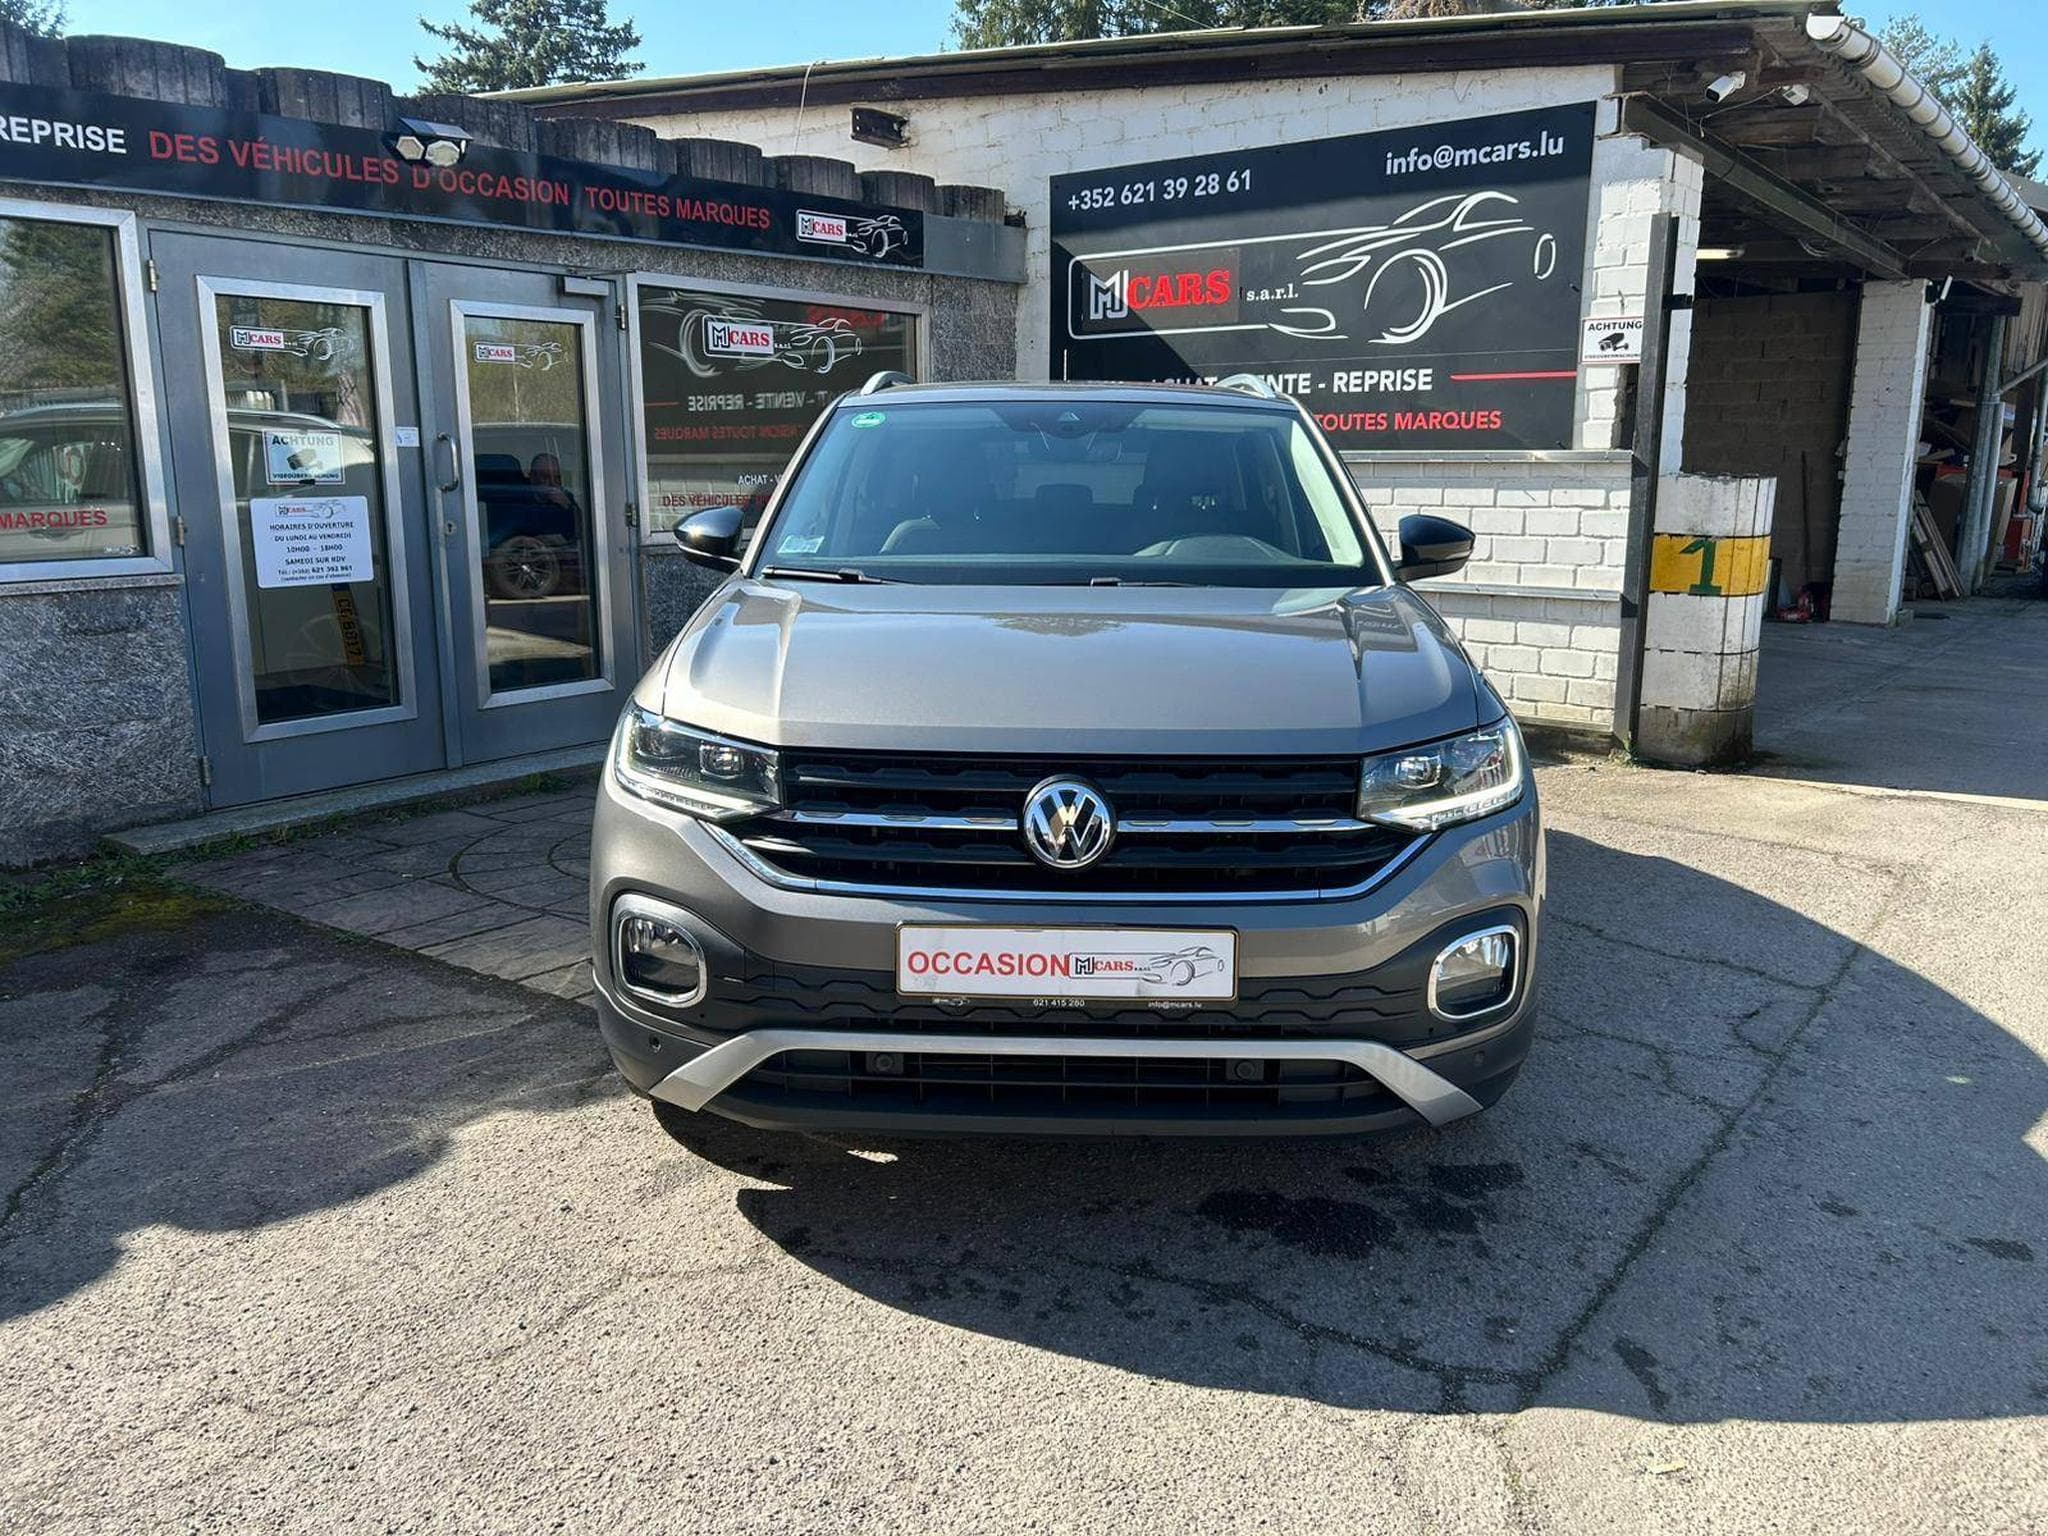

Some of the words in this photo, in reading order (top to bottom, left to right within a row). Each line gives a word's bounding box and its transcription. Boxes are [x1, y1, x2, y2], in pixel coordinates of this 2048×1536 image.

[1385, 130, 1565, 175] info@mcars.lu
[149, 131, 220, 164] DES
[229, 136, 400, 184] VÉHICULES
[411, 163, 569, 206] D'OCCASION
[584, 185, 670, 218] TOUTES
[676, 198, 771, 230] MARQUES
[1068, 187, 1115, 210] +352
[1121, 182, 1155, 205] 621
[1163, 178, 1188, 201] 39
[1194, 173, 1220, 197] 28
[1226, 169, 1251, 192] 61
[1246, 283, 1299, 301] s.a.r.l.
[1587, 320, 1643, 331] ACHTUNG
[1333, 368, 1434, 393] REPRISE
[1394, 410, 1503, 431] MARQUES
[272, 434, 334, 446] ACHTUNG
[738, 474, 768, 486] ACHAT
[663, 495, 686, 507] DES
[0, 510, 108, 529] MARQUES
[1679, 538, 1722, 597] 1
[907, 951, 1070, 977] OCCASION
